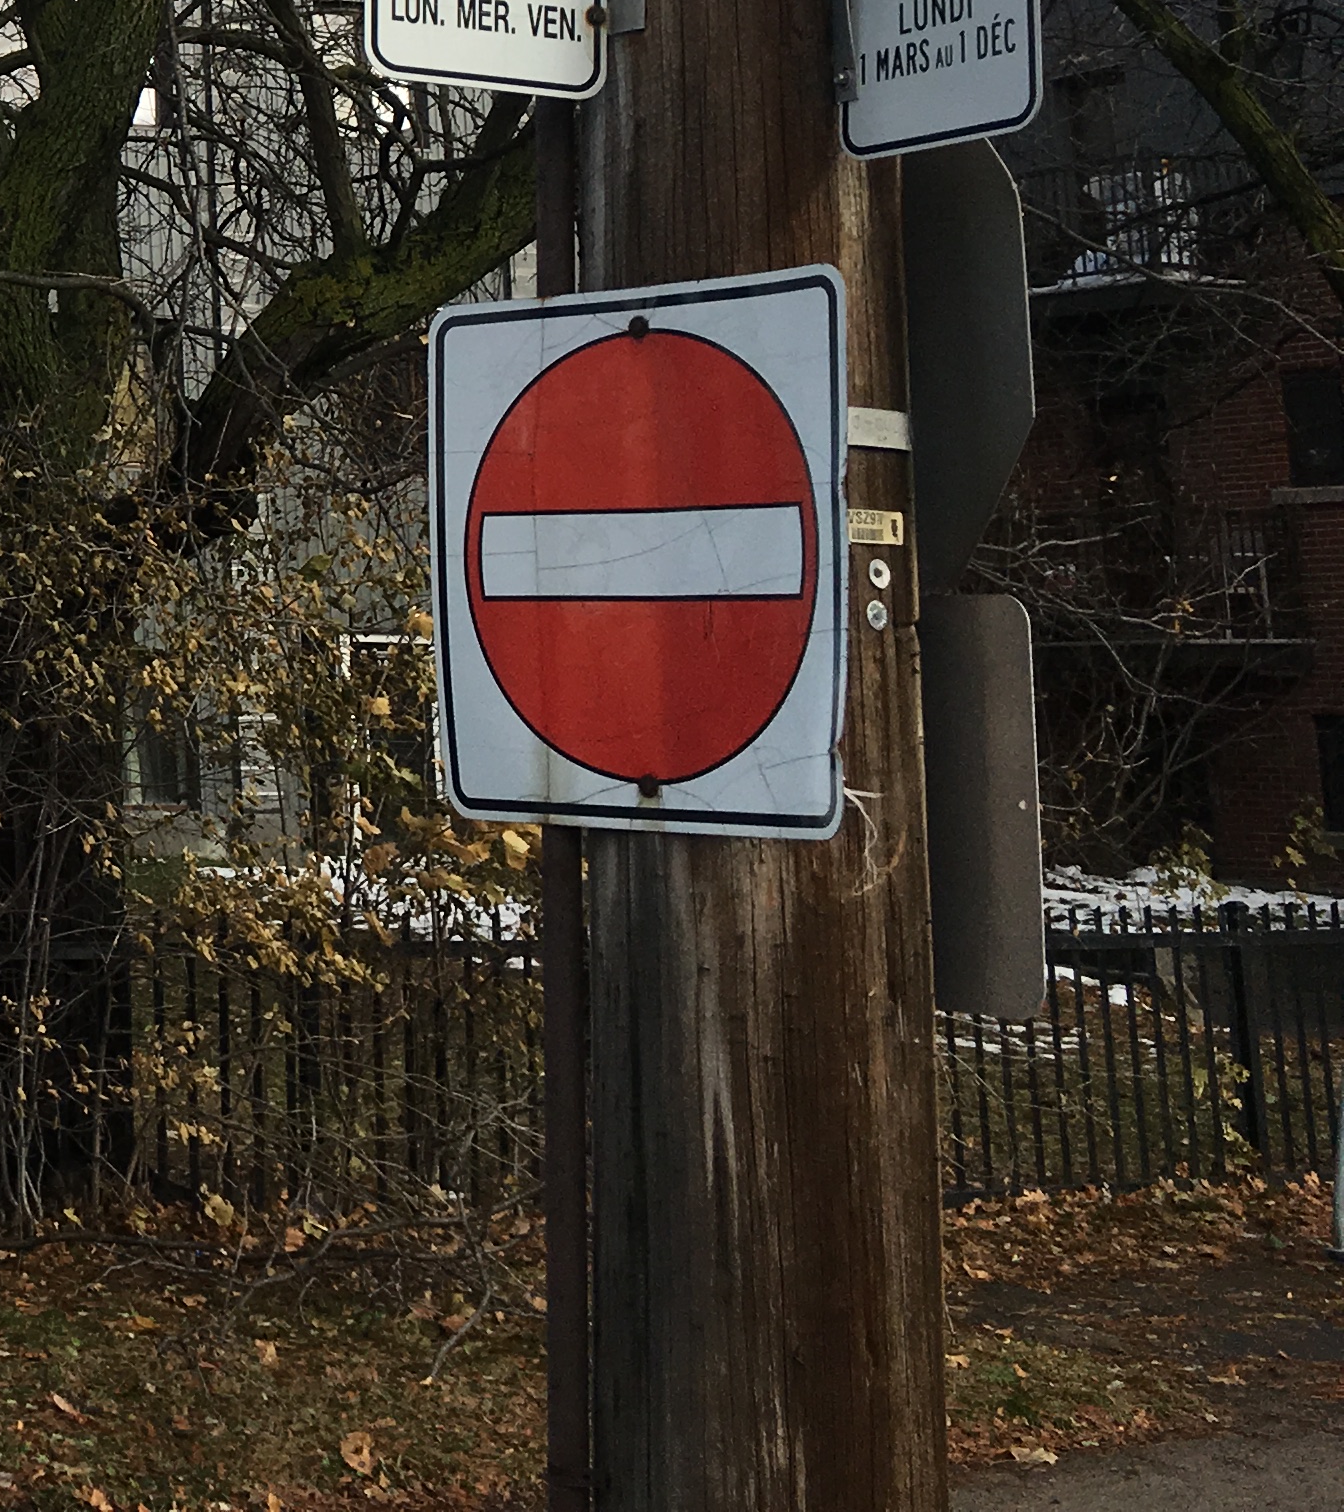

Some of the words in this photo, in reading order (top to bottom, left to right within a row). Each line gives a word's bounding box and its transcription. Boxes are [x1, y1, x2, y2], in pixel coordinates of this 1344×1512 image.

[528, 3, 582, 43] VEN.
[858, 52, 867, 85] 1
[876, 38, 930, 83] MARS
[935, 45, 954, 70] AU
[958, 29, 967, 64] 1
[976, 11, 1017, 60] DÉC
